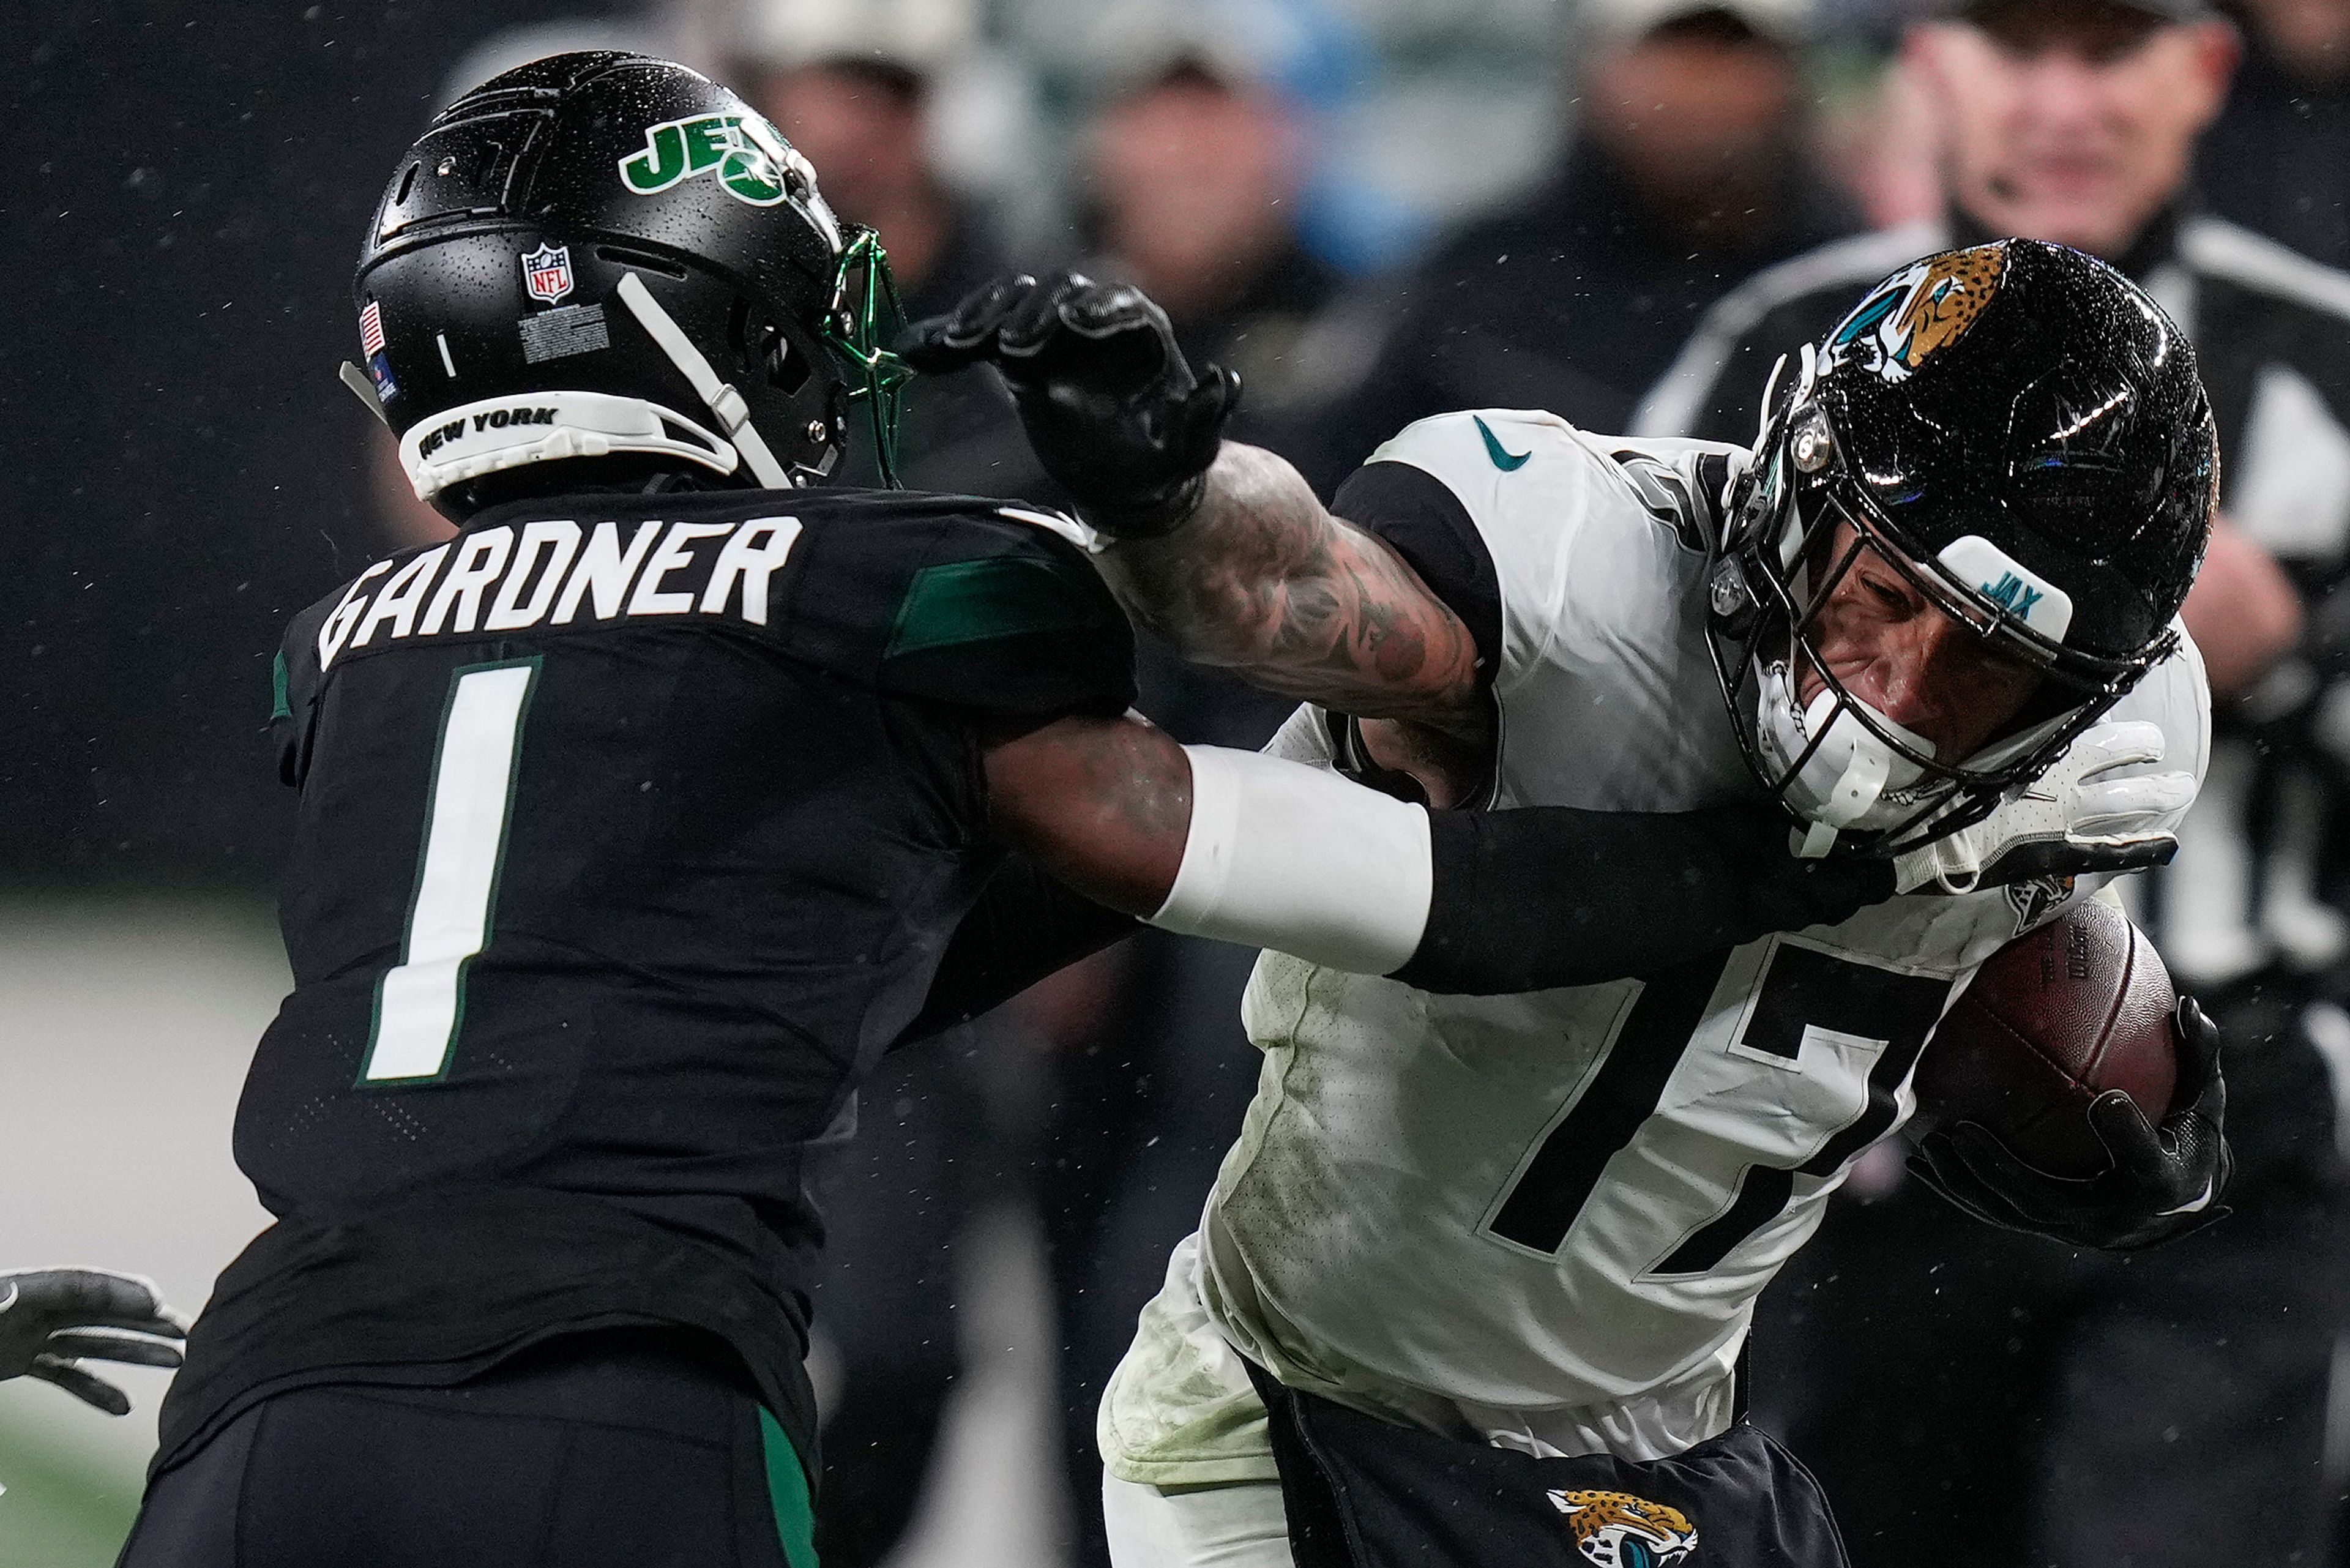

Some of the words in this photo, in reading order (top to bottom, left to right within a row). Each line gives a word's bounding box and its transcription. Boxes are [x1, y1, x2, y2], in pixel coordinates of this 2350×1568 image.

[532, 269, 567, 294] NFL
[418, 418, 466, 460] NEW
[472, 408, 559, 433] YORK
[318, 515, 804, 673] GARDNER
[1981, 570, 2044, 620] JAX
[360, 660, 539, 1085] 1
[1480, 936, 1956, 1279] 17
